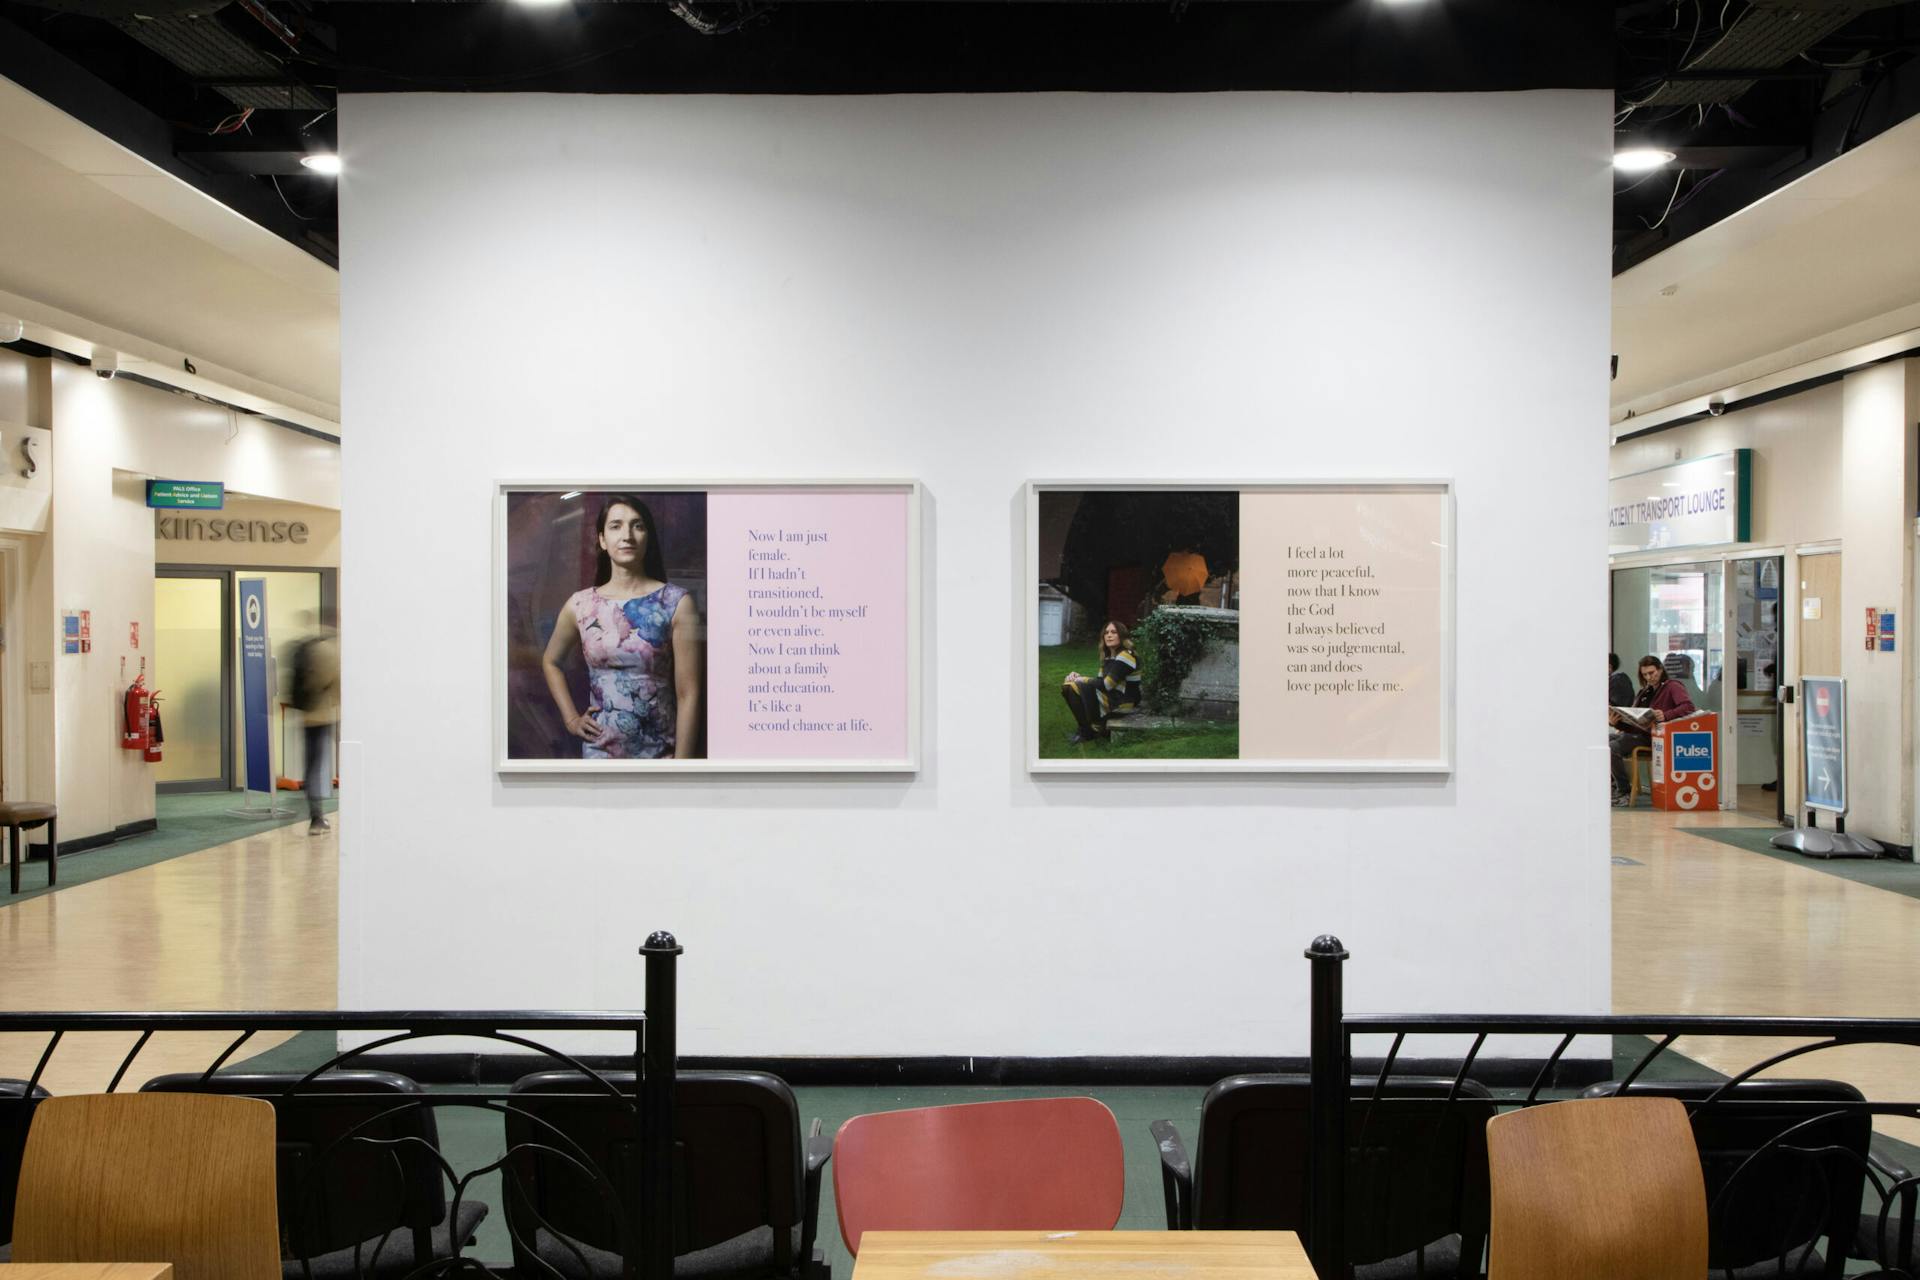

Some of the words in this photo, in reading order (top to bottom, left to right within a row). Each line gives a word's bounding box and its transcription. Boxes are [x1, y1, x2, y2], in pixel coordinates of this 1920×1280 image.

[1636, 495, 1685, 523] TRANSPORT
[1687, 487, 1725, 515] LOUNGE
[748, 529, 775, 542] Now
[779, 529, 783, 542] I
[786, 533, 804, 542] am
[805, 529, 828, 546] just
[748, 548, 791, 561] female.
[1287, 545, 1292, 560] I
[1295, 545, 1317, 560] feel
[1319, 550, 1326, 560] a
[1328, 545, 1344, 560] lot
[749, 567, 760, 580] If
[761, 567, 765, 580] I
[1287, 568, 1318, 579] more
[1321, 565, 1376, 583] peaceful,
[748, 586, 824, 600] transitioned,
[1287, 587, 1312, 597] now
[1314, 583, 1338, 598] that
[1340, 583, 1345, 598] I
[1348, 583, 1380, 598] know
[748, 604, 753, 618] I
[811, 605, 826, 618] be
[828, 604, 869, 622] myself
[1287, 602, 1307, 617] the
[1308, 602, 1335, 617] God
[747, 627, 762, 637] or
[763, 627, 792, 637] even
[793, 624, 825, 637] alive.
[1287, 621, 1292, 635] I
[1294, 621, 1334, 639] always
[1335, 621, 1385, 636] believed
[748, 642, 775, 655] Now
[779, 642, 783, 656] I
[786, 647, 807, 656] can
[809, 642, 841, 656] think
[1286, 644, 1310, 654] was
[1311, 644, 1325, 654] so
[1326, 640, 1405, 658] judgemental,
[747, 662, 781, 675] about
[784, 665, 792, 675] a
[794, 661, 829, 679] family
[1286, 663, 1308, 673] can
[1309, 659, 1332, 673] and
[1334, 659, 1363, 673] does
[748, 680, 770, 694] and
[772, 680, 835, 694] education.
[1287, 678, 1312, 692] love
[1313, 678, 1355, 696] people
[1357, 678, 1380, 692] like
[1382, 682, 1404, 692] me.
[770, 699, 793, 713] like
[794, 703, 802, 713] a
[748, 718, 791, 732] second
[792, 718, 834, 732] chance
[836, 721, 847, 732] at
[850, 718, 873, 732] life.
[1675, 744, 1709, 757] Pulse
